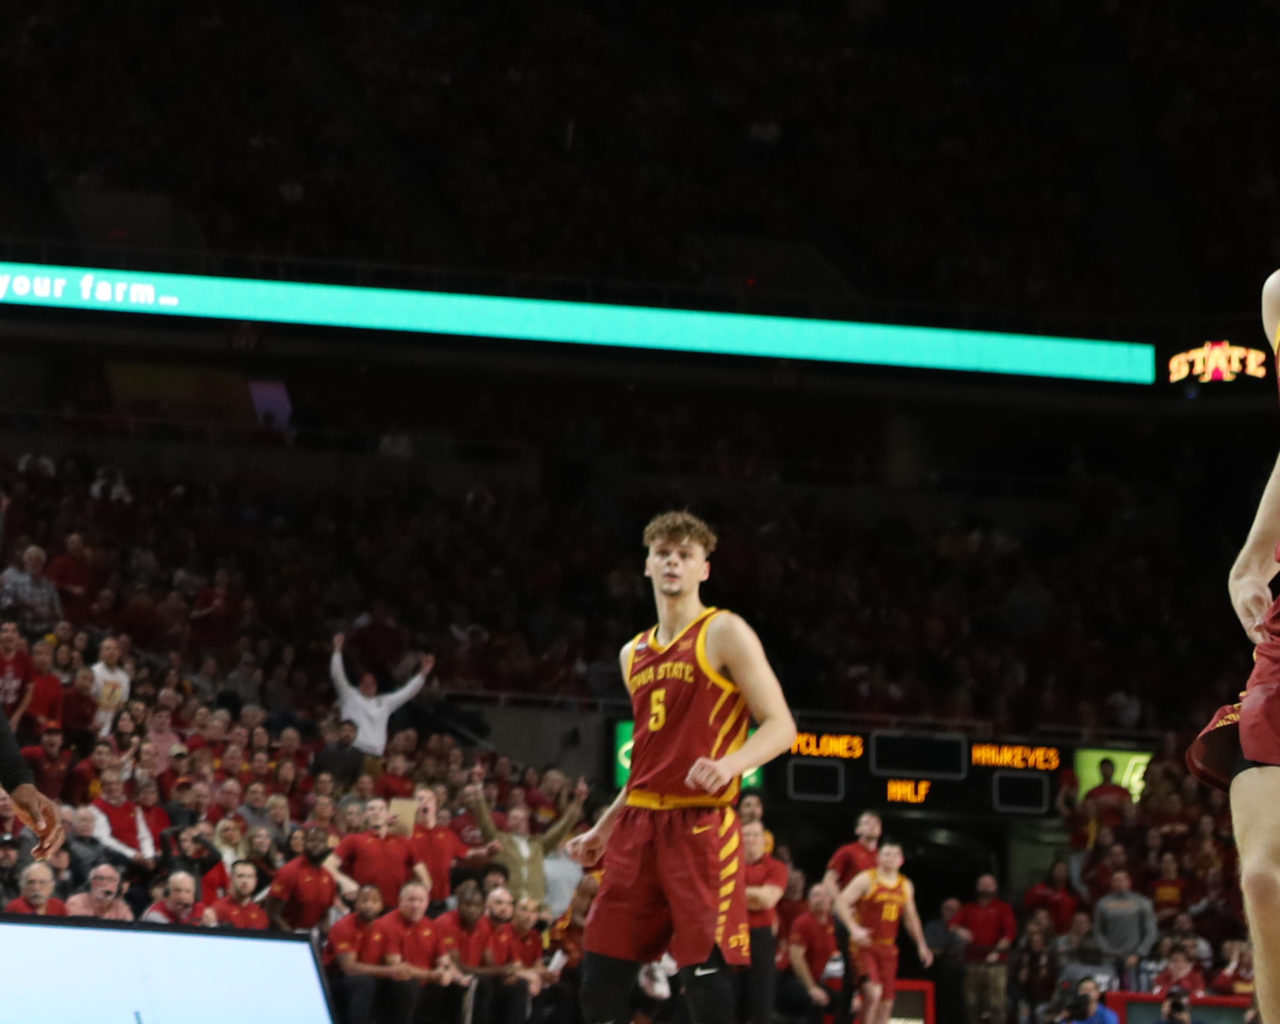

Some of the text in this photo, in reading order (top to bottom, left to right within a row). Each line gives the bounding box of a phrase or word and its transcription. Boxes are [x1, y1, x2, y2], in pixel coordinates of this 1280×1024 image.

[1168, 344, 1266, 384] STATE
[648, 688, 667, 732] 5
[790, 731, 864, 759] YCLONES
